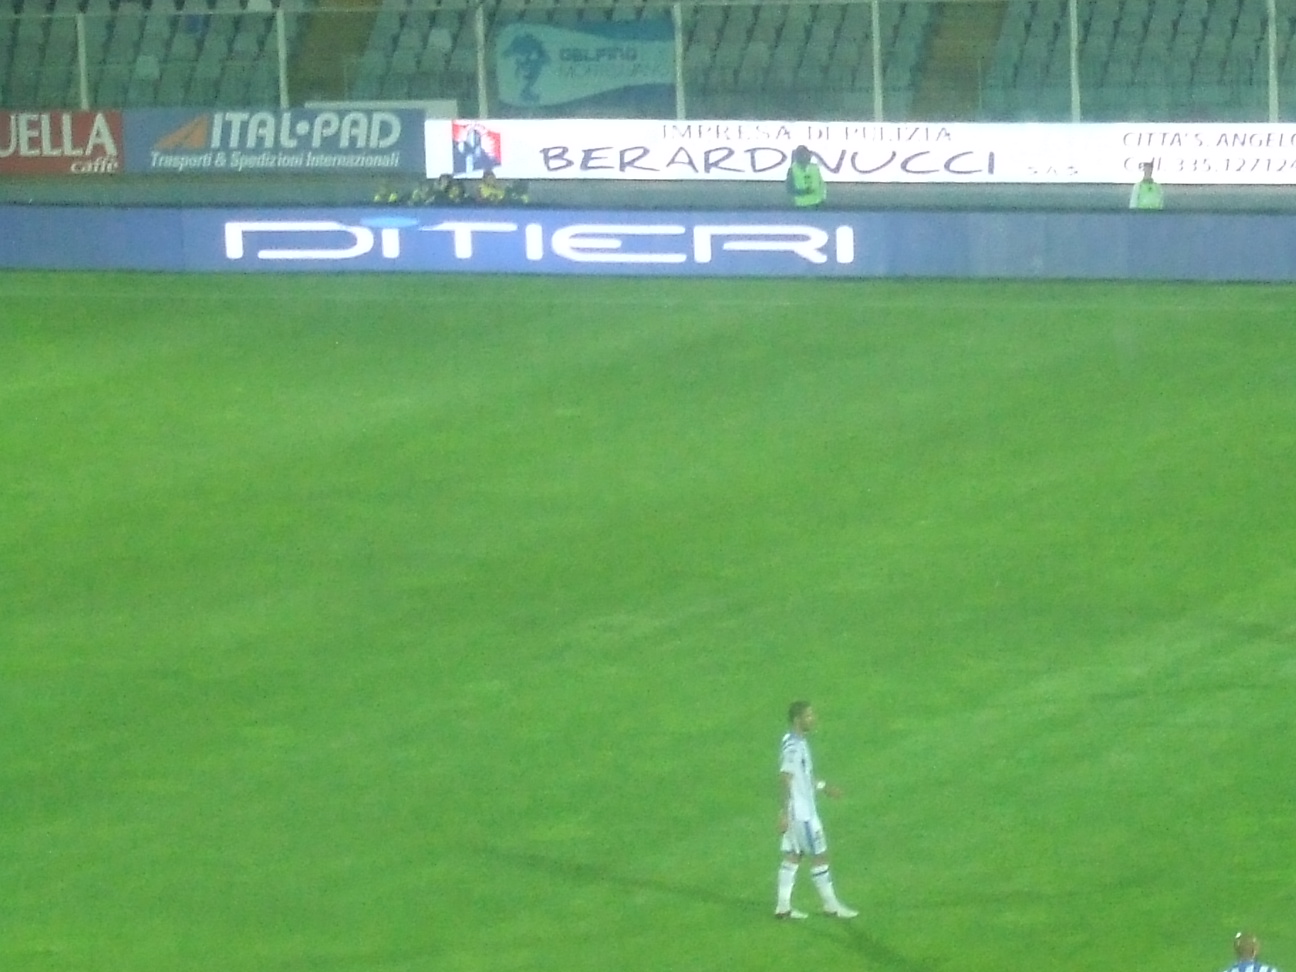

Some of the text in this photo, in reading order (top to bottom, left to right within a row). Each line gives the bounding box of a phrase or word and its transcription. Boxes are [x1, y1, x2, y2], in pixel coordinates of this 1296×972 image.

[662, 124, 791, 140] IMPRESA
[214, 152, 227, 168] &
[230, 151, 304, 172] Spedizioni
[306, 151, 400, 168] Internazionali
[539, 146, 995, 175] BERARDNUCCI
